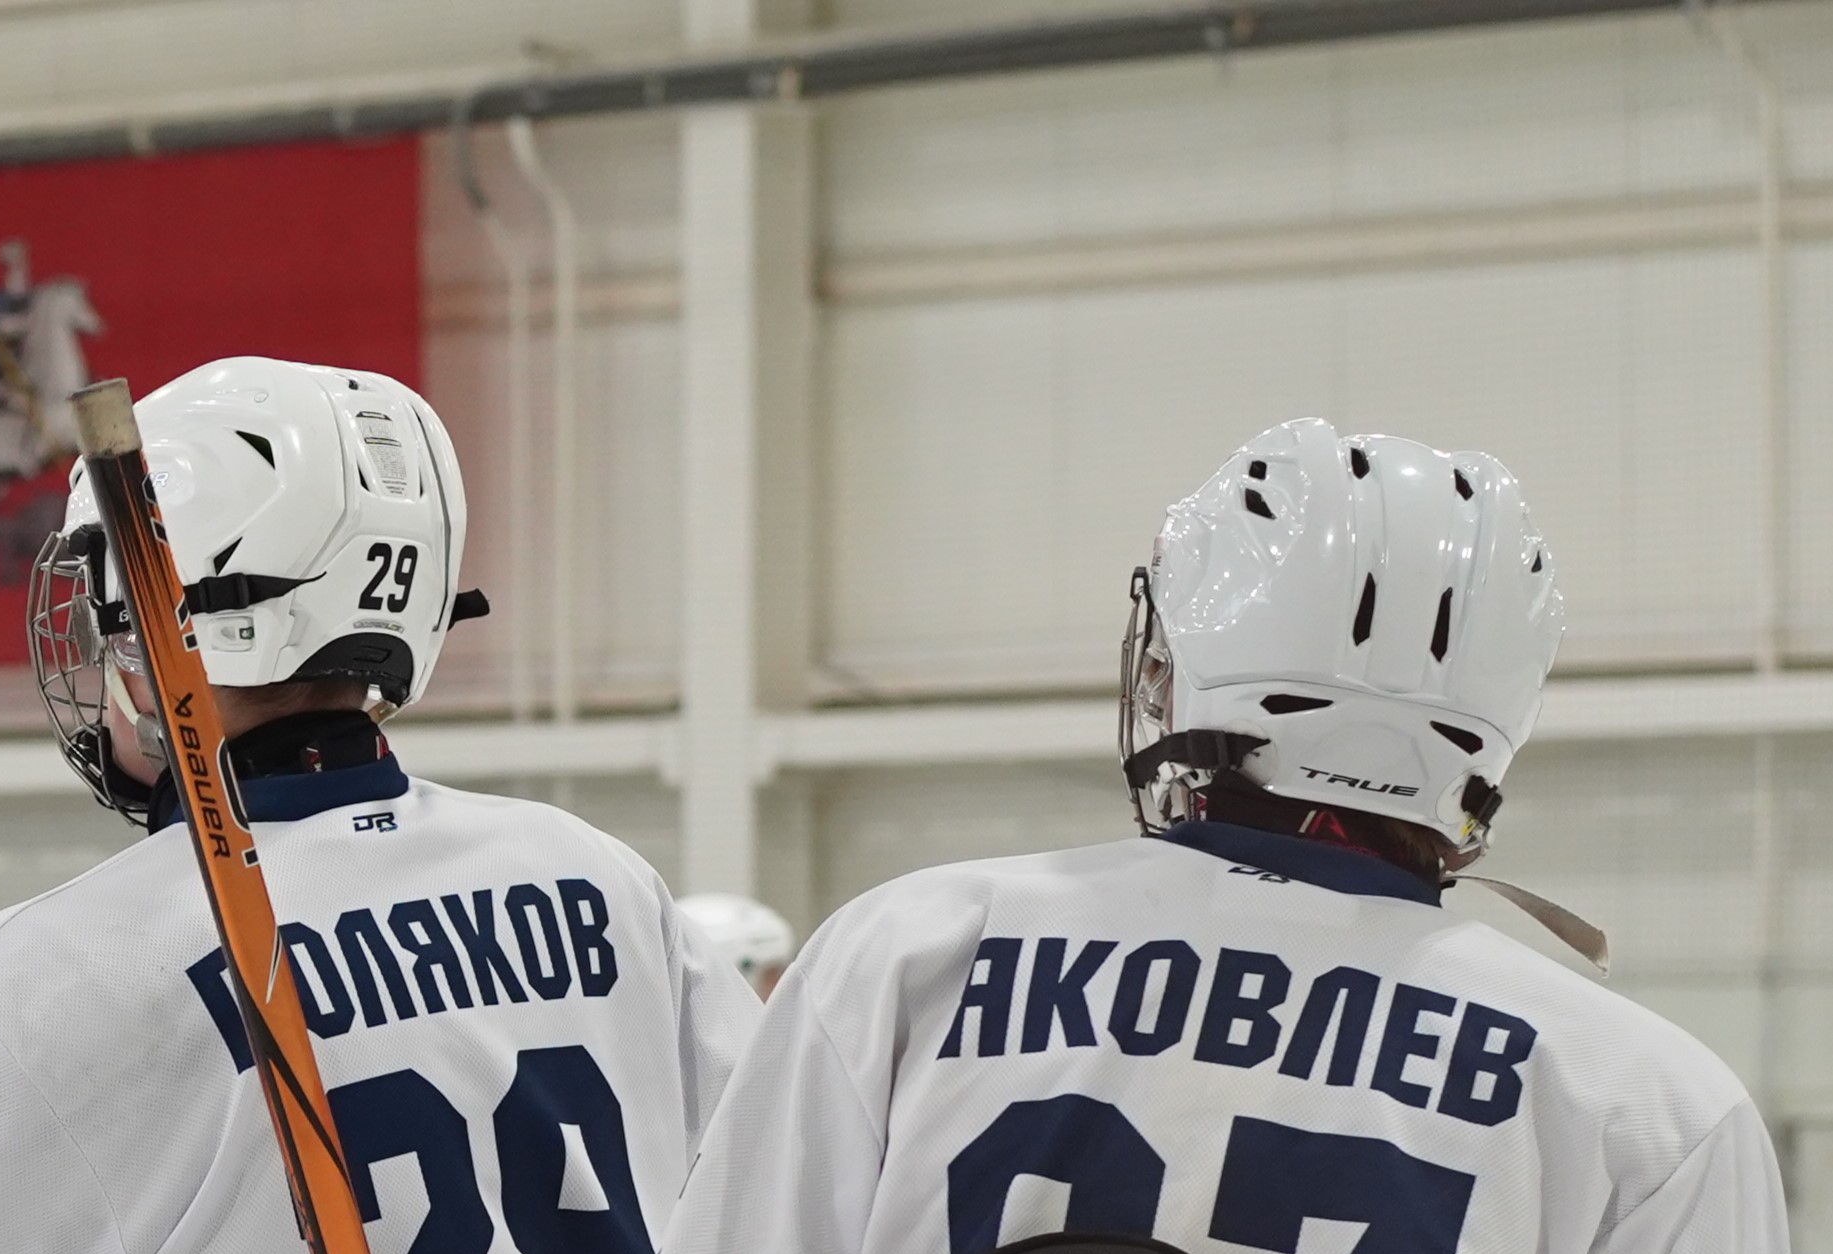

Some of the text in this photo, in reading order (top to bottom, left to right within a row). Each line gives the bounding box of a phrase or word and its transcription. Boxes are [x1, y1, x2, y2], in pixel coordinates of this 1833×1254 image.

[358, 542, 418, 613] 29
[178, 724, 231, 859] BAUER
[1300, 766, 1420, 797] TRUE
[936, 936, 1539, 1127] ЯКОВЛЕВ
